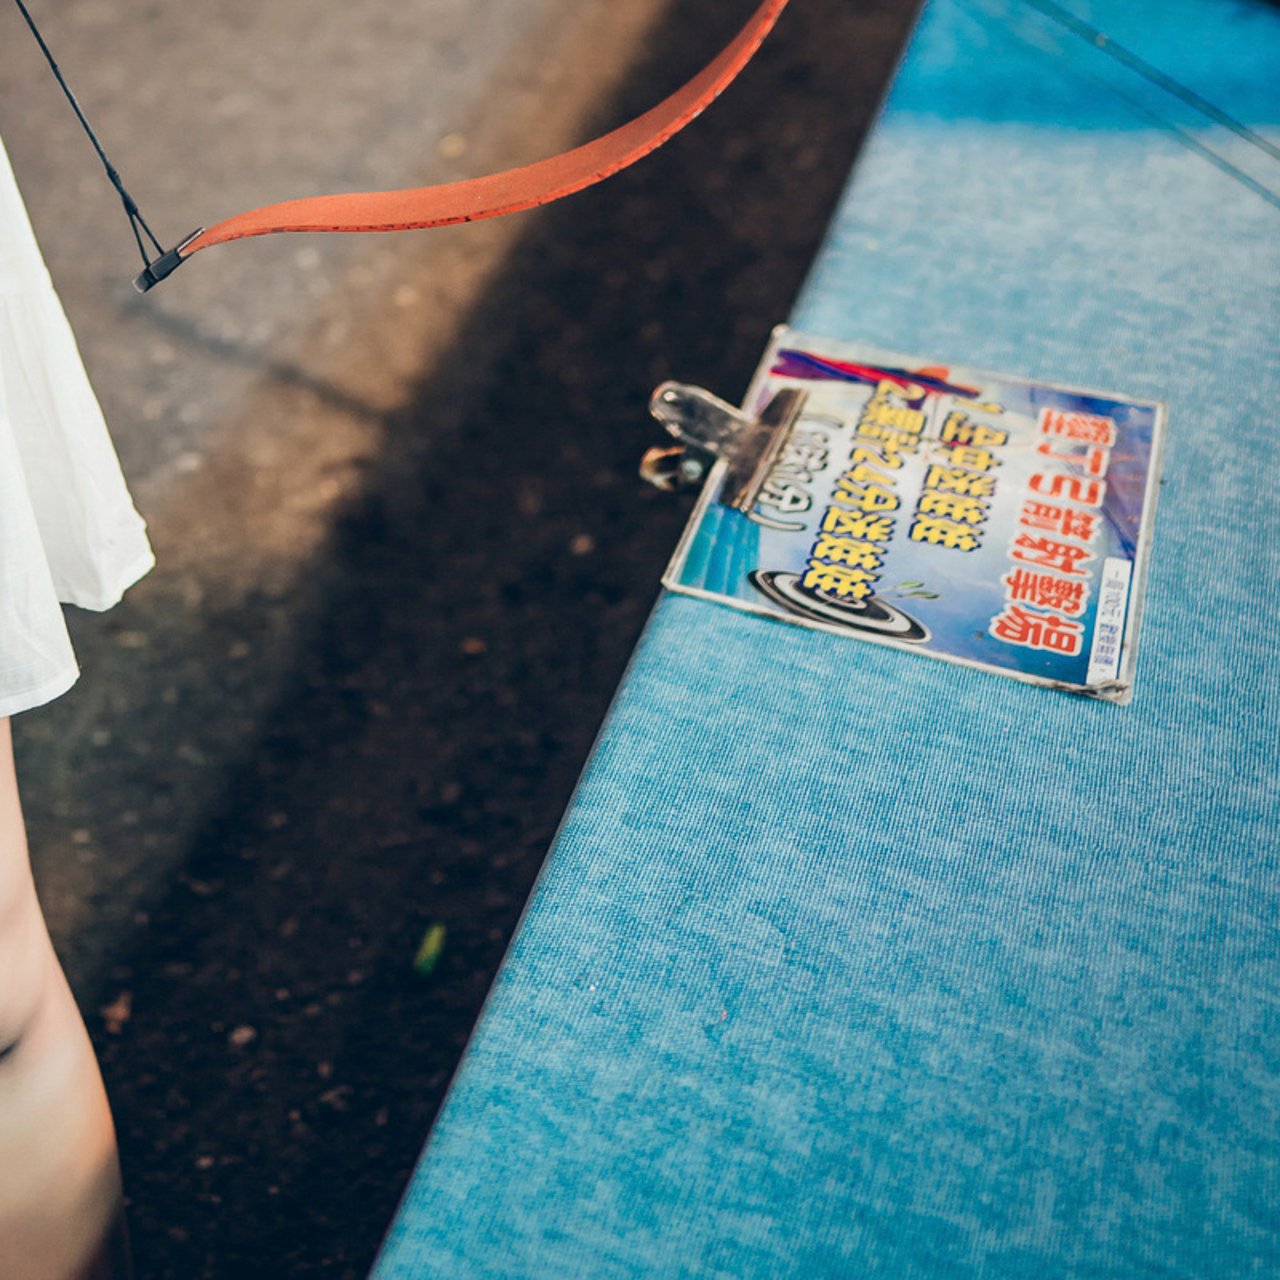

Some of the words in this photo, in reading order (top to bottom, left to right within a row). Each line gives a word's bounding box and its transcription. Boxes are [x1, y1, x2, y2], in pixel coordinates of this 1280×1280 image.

[992, 409, 1115, 655] 墾丁弓箭射擊場
